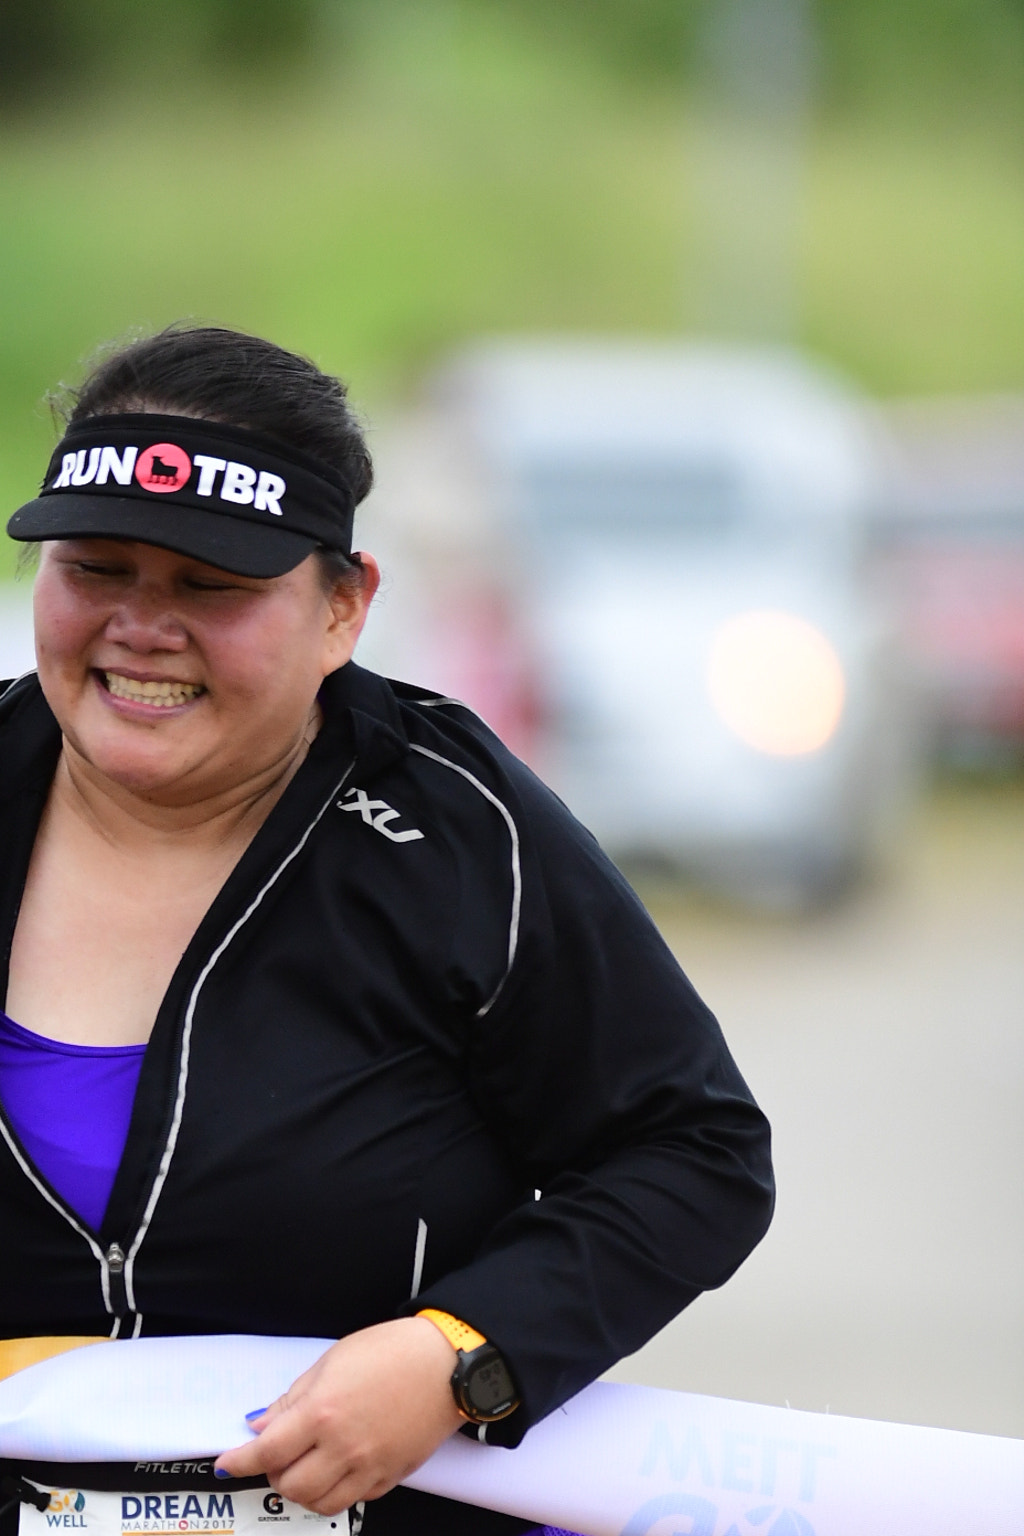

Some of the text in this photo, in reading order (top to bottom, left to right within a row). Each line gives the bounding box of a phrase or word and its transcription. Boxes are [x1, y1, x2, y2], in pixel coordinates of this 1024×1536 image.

[53, 445, 287, 516] RUN TBR
[134, 1462, 211, 1474] FITLETIC
[121, 1494, 235, 1520] DREAM
[46, 1514, 88, 1528] WELL
[203, 1519, 235, 1530] 2017
